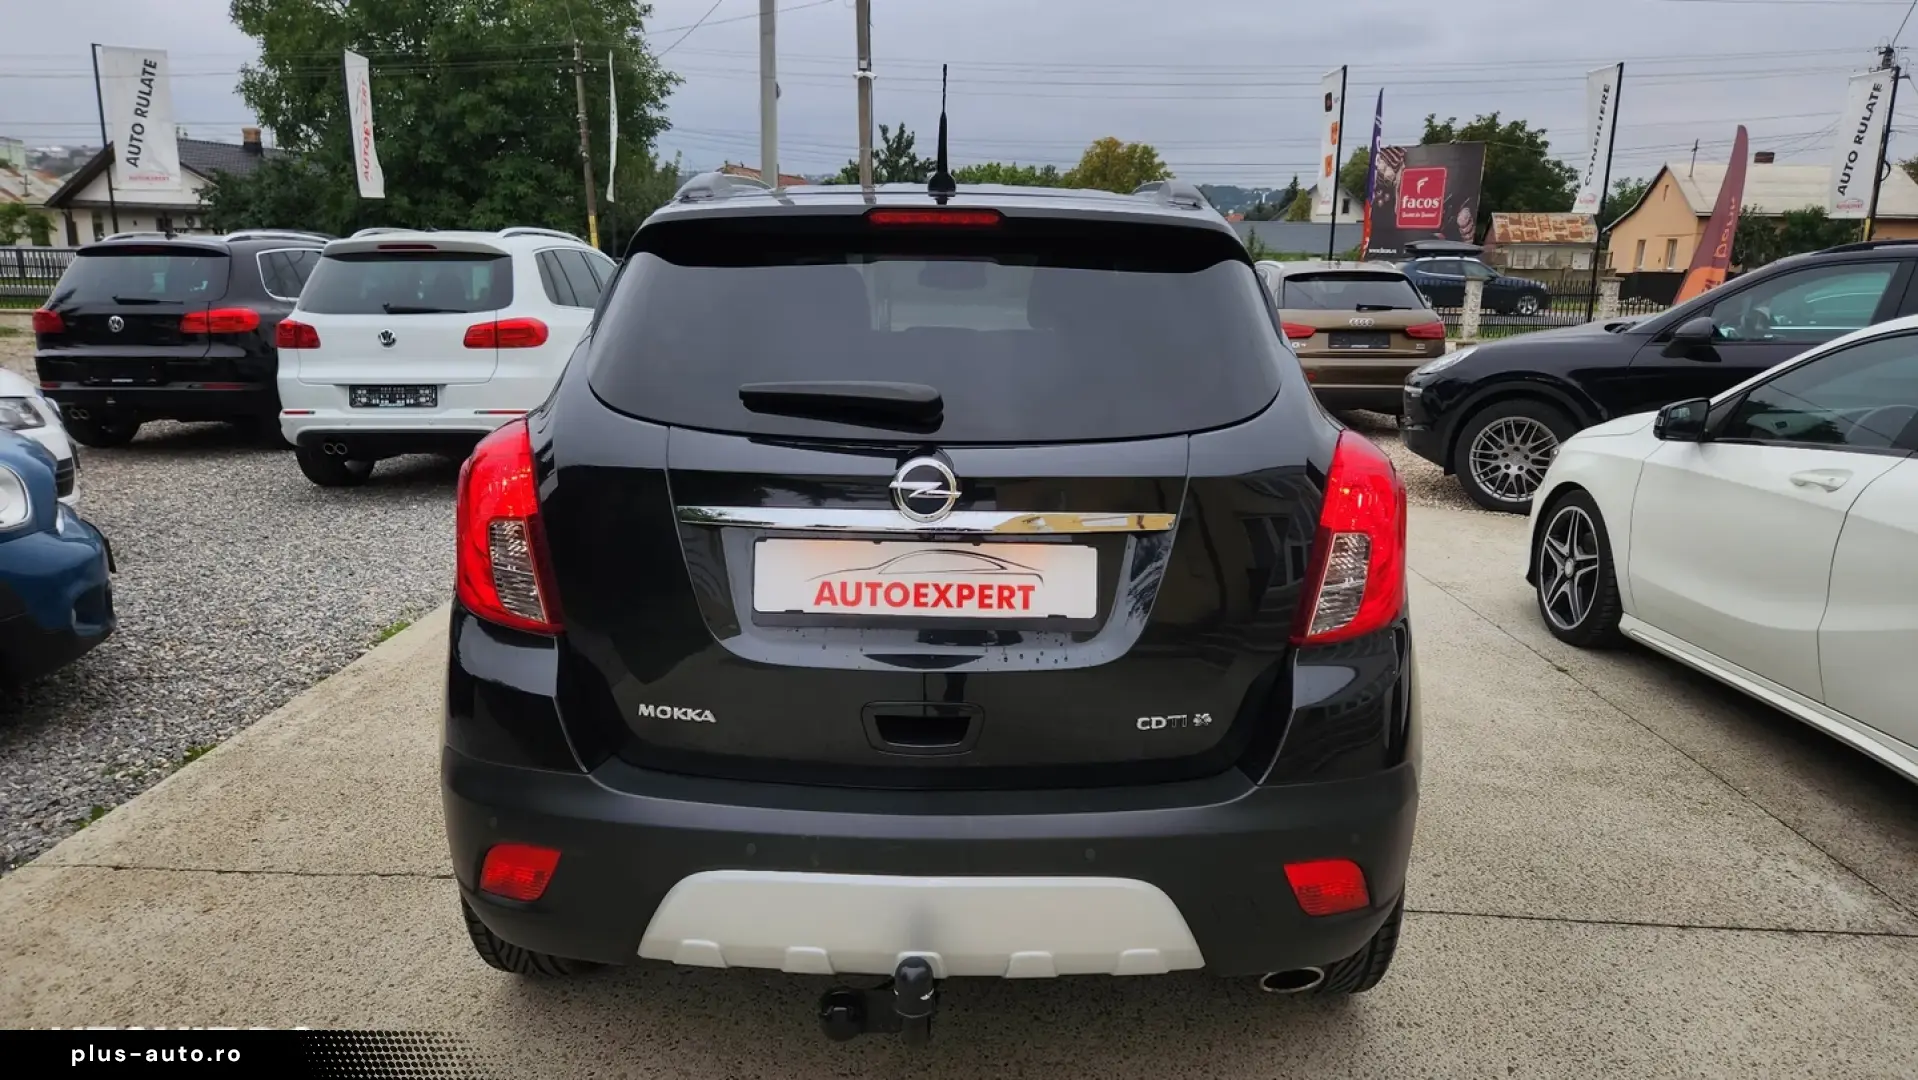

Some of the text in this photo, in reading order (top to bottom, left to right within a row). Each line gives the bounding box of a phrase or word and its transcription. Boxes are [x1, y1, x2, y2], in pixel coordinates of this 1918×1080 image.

[125, 58, 158, 169] AUTO RULATE
[1837, 150, 1859, 196] AUTO
[1853, 82, 1883, 145] RULATE
[1402, 194, 1440, 209] facos
[813, 581, 1036, 611] AUTOEXPERT
[638, 703, 717, 724] MOKKA
[1136, 714, 1188, 731] CDTI
